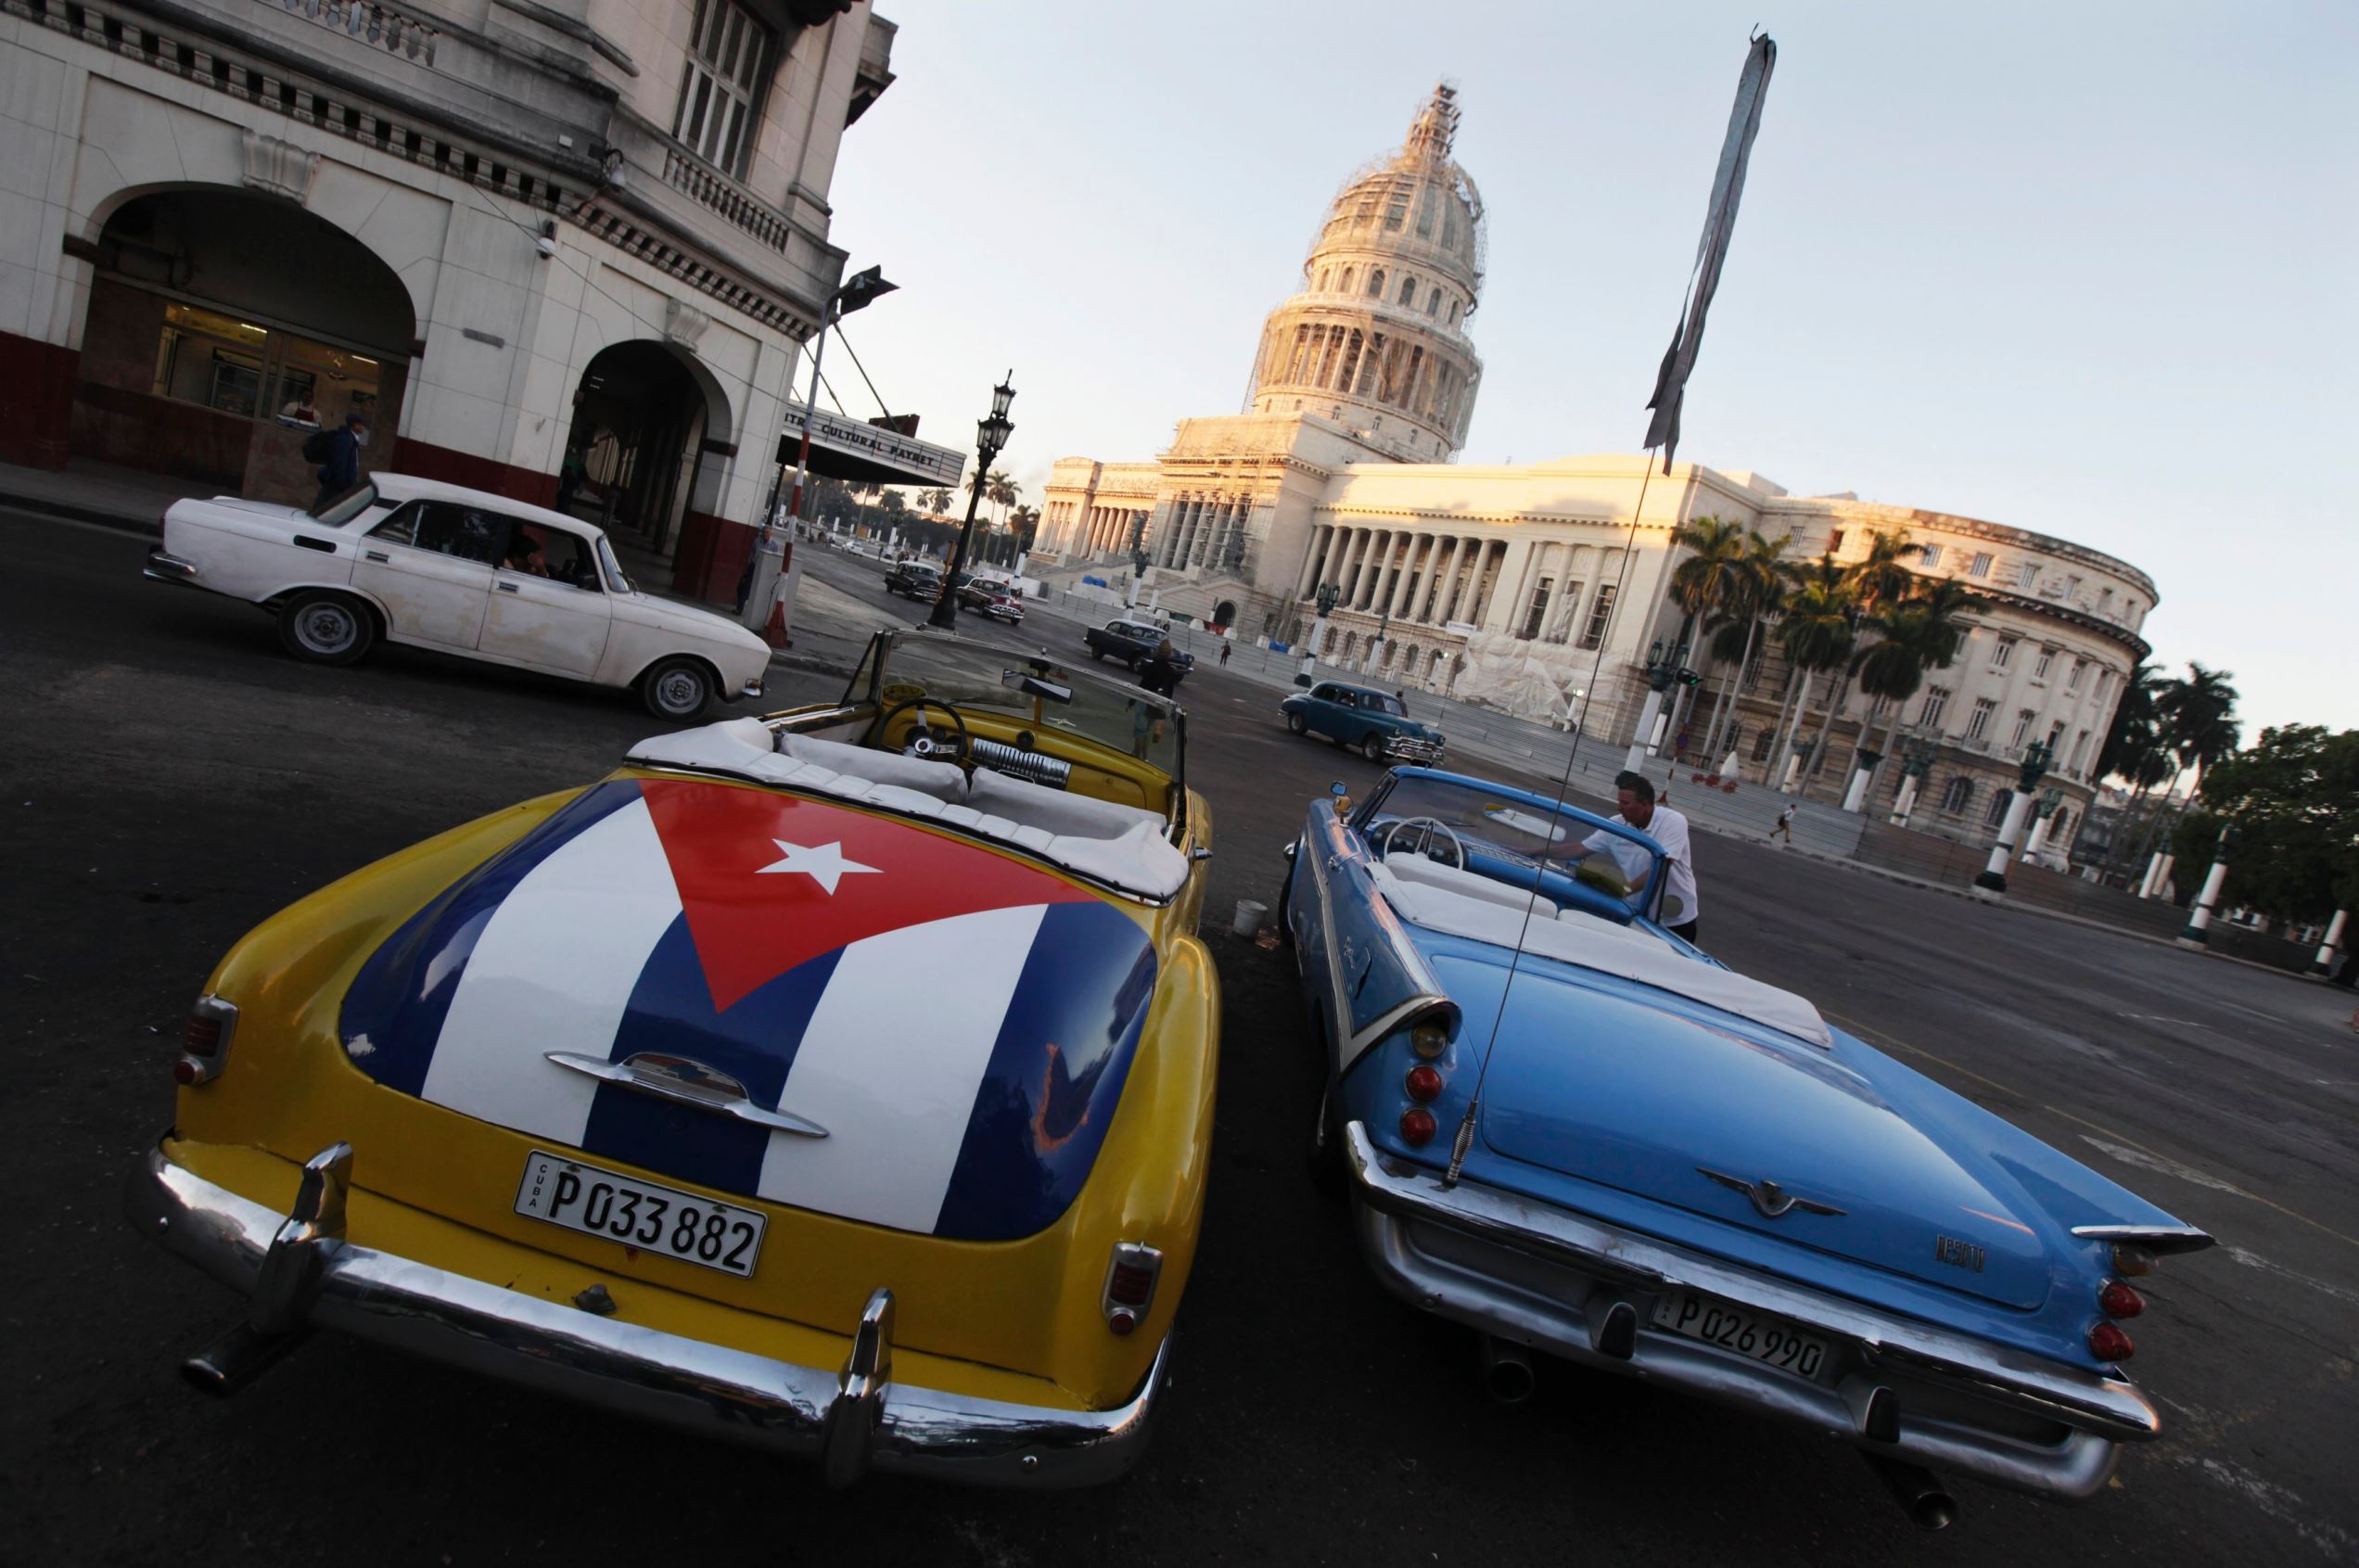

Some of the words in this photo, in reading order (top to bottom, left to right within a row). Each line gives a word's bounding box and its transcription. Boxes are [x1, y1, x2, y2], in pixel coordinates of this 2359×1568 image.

[822, 425, 883, 452] CULTURAL
[890, 446, 935, 466] PAYRET
[529, 1164, 547, 1208] CUBA
